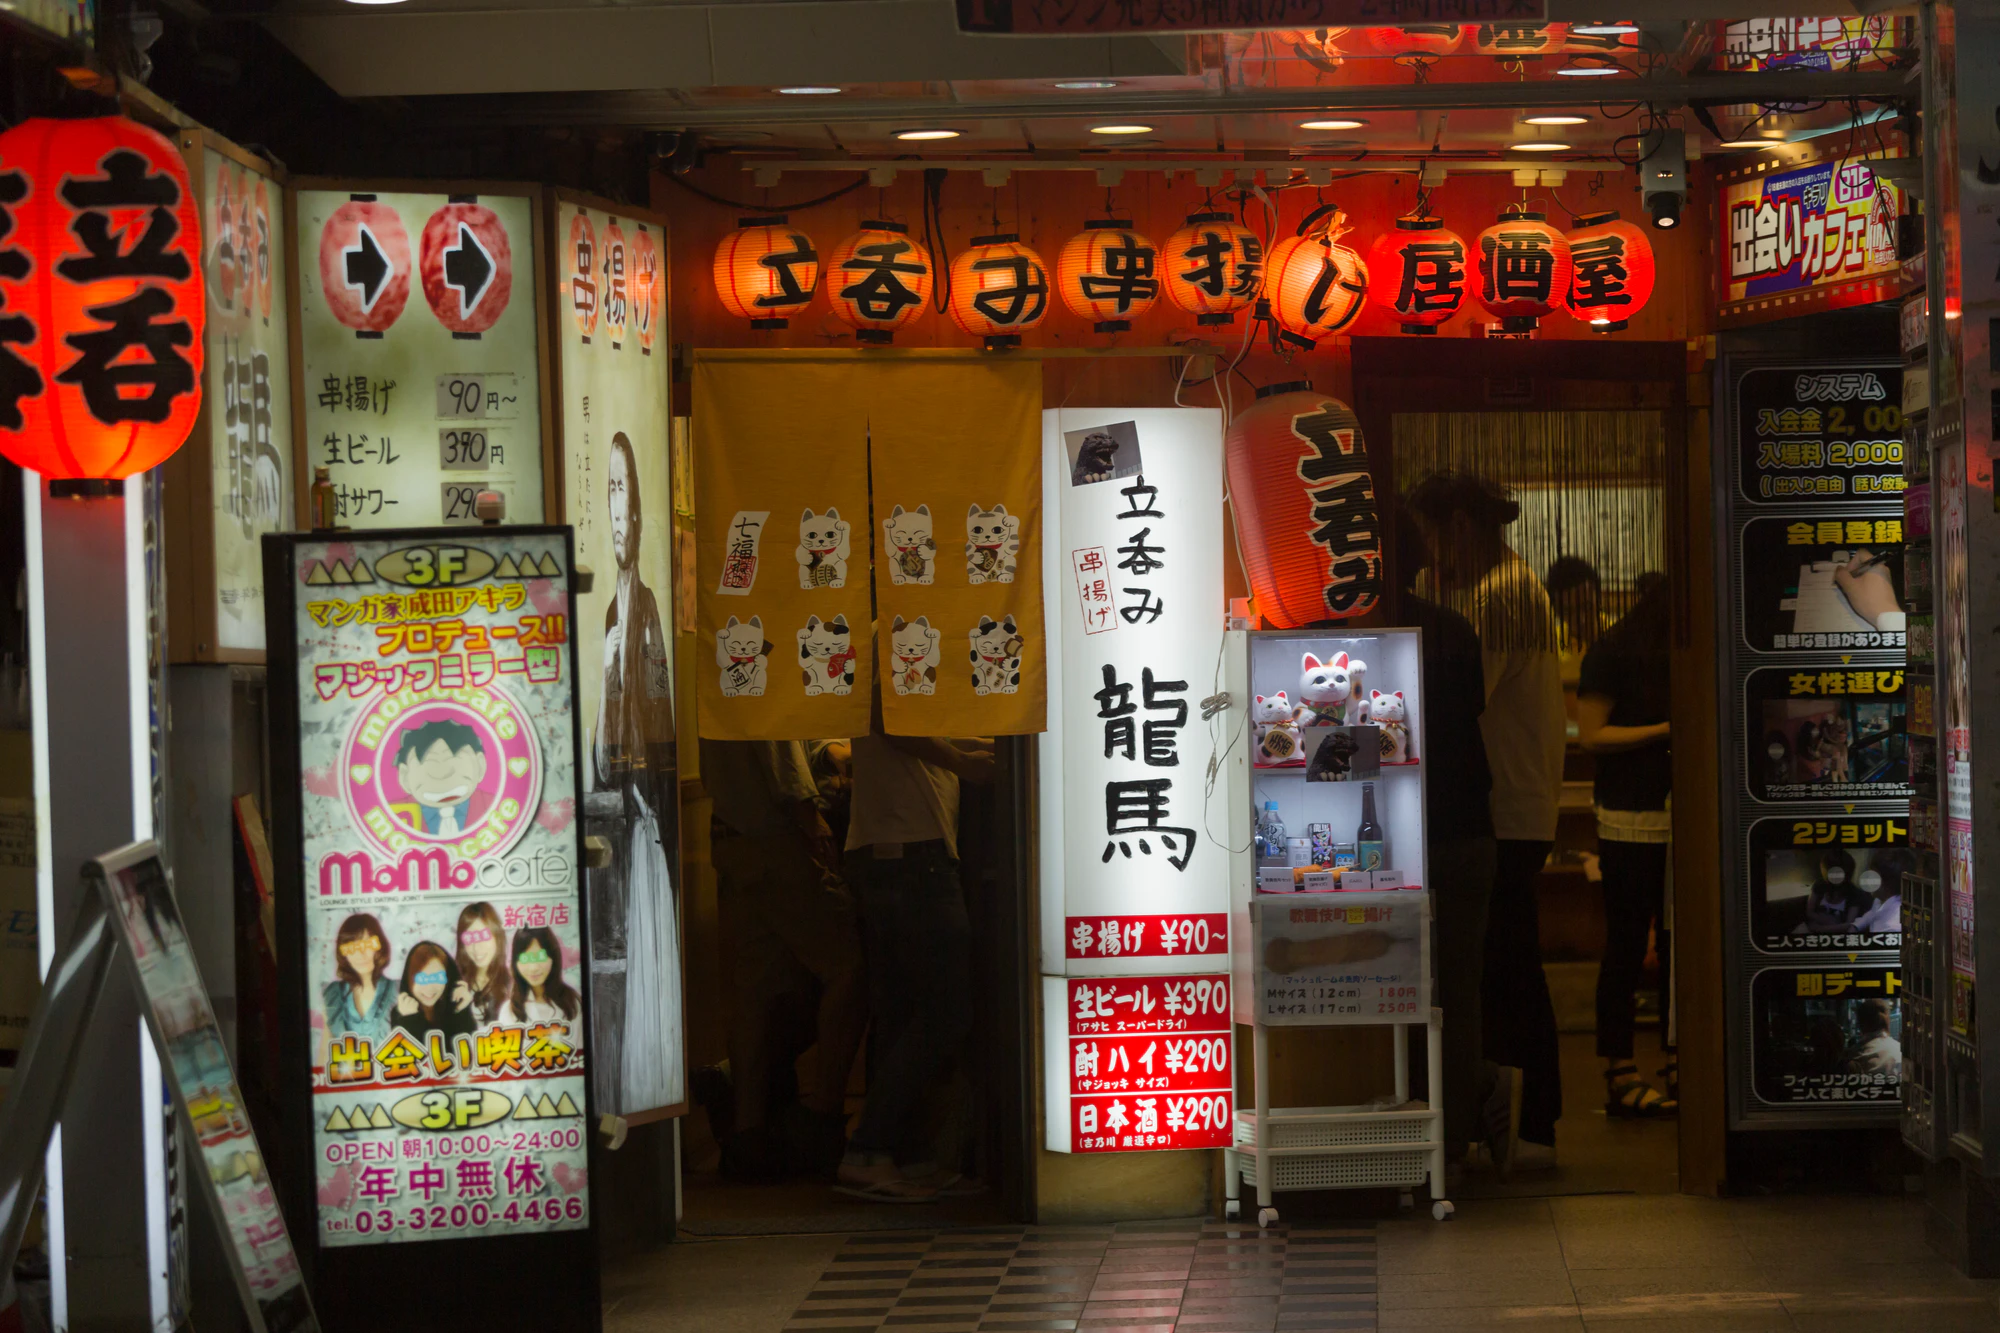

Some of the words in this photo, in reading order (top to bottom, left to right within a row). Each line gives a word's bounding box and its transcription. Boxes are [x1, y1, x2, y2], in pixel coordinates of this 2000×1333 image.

[1732, 199, 1865, 277] 出会いカフェ
[54, 150, 196, 425] 立呑
[572, 226, 657, 332] 串揚げ
[318, 373, 397, 415] 串揚げ
[1798, 375, 1885, 400] システム
[1757, 409, 1822, 434] 入会金
[1827, 406, 1902, 435] 2,00
[323, 432, 400, 465] 生ビール
[1757, 441, 1822, 468] 入場料
[1292, 401, 1384, 614] 立呑み
[1117, 474, 1166, 624] 立呑み
[1787, 520, 1903, 545] 会員登録
[405, 548, 466, 585] 3F
[307, 584, 526, 627] マンガ家成田アキラ
[1079, 550, 1111, 627] 串揚げ
[376, 614, 566, 656] プロデュース!!
[315, 645, 561, 700] マジックミラー型
[1788, 670, 1904, 695] 女性選び
[1094, 664, 1197, 872] 龍馬
[1793, 820, 1907, 845] 2ショット
[320, 898, 348, 906] LOUNGE
[350, 897, 372, 905] STYLE
[503, 903, 570, 927] 新宿店
[1289, 907, 1393, 924] 歌舞伎町揚げ
[1071, 920, 1146, 956] 串揚げ
[1766, 933, 1902, 948] 二人っきりで楽しくお
[1074, 984, 1156, 1019] 生ビール
[1164, 980, 1227, 1016] ¥390
[1378, 986, 1417, 998] 180円
[1796, 971, 1902, 997] 即デート
[1377, 1002, 1417, 1013] 250円
[329, 1022, 574, 1083] 出会い喫茶
[1075, 1041, 1157, 1078] 酎ハイ
[1165, 1038, 1227, 1075] ¥290
[1783, 1073, 1902, 1087] フィーリングが合っ
[420, 1091, 482, 1128] 3F
[1079, 1097, 1158, 1135] 日本酒
[1166, 1095, 1228, 1132] ¥290
[326, 1141, 395, 1163] OPEN
[359, 1155, 544, 1203] 年中無休
